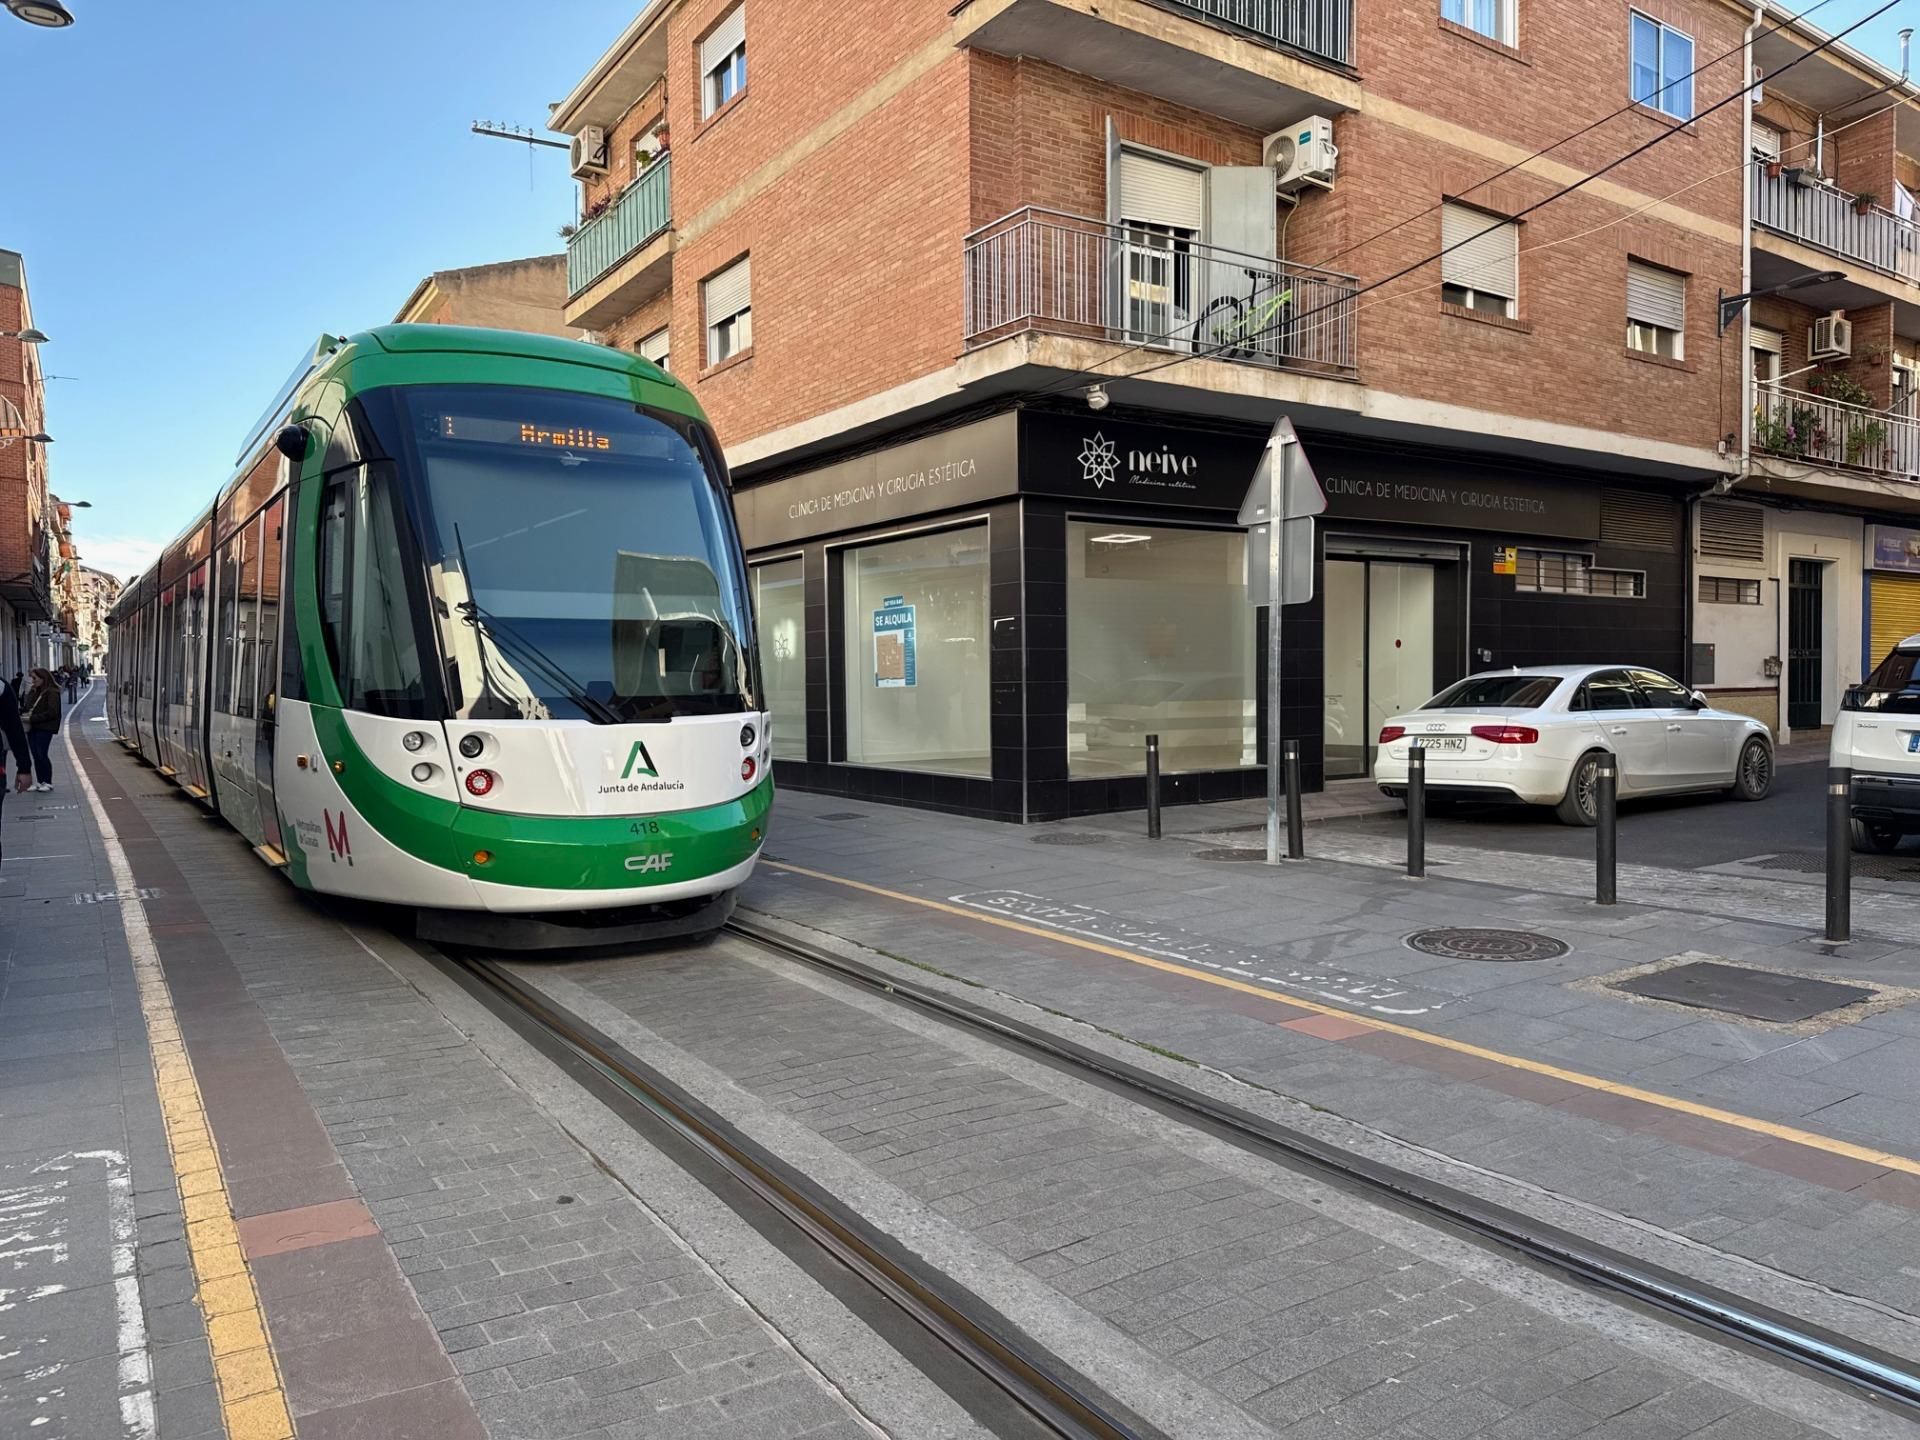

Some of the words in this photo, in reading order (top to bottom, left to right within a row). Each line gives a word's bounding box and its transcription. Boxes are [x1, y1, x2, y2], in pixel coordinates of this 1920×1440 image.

[521, 423, 610, 450] Armilla
[1128, 444, 1198, 476] neive
[788, 497, 820, 520] CLÍNICA
[821, 495, 833, 512] DE
[834, 484, 876, 509] MEDICINA
[877, 482, 885, 497] Y
[886, 471, 926, 497] CIRUGÍA
[928, 458, 977, 487] ESTÉTICA
[1325, 476, 1373, 497] CLÍNICA
[1376, 482, 1391, 498] DE
[1394, 485, 1448, 504] MEDICINA
[1451, 490, 1459, 504] Y
[875, 616, 884, 627] SE
[884, 612, 913, 626] ALQUILA
[1443, 738, 1463, 749] HNZ
[597, 783, 626, 794] Junta
[627, 782, 638, 792] de
[640, 779, 685, 791] Andalucía
[629, 821, 660, 836] 418
[624, 852, 674, 874] CAF
